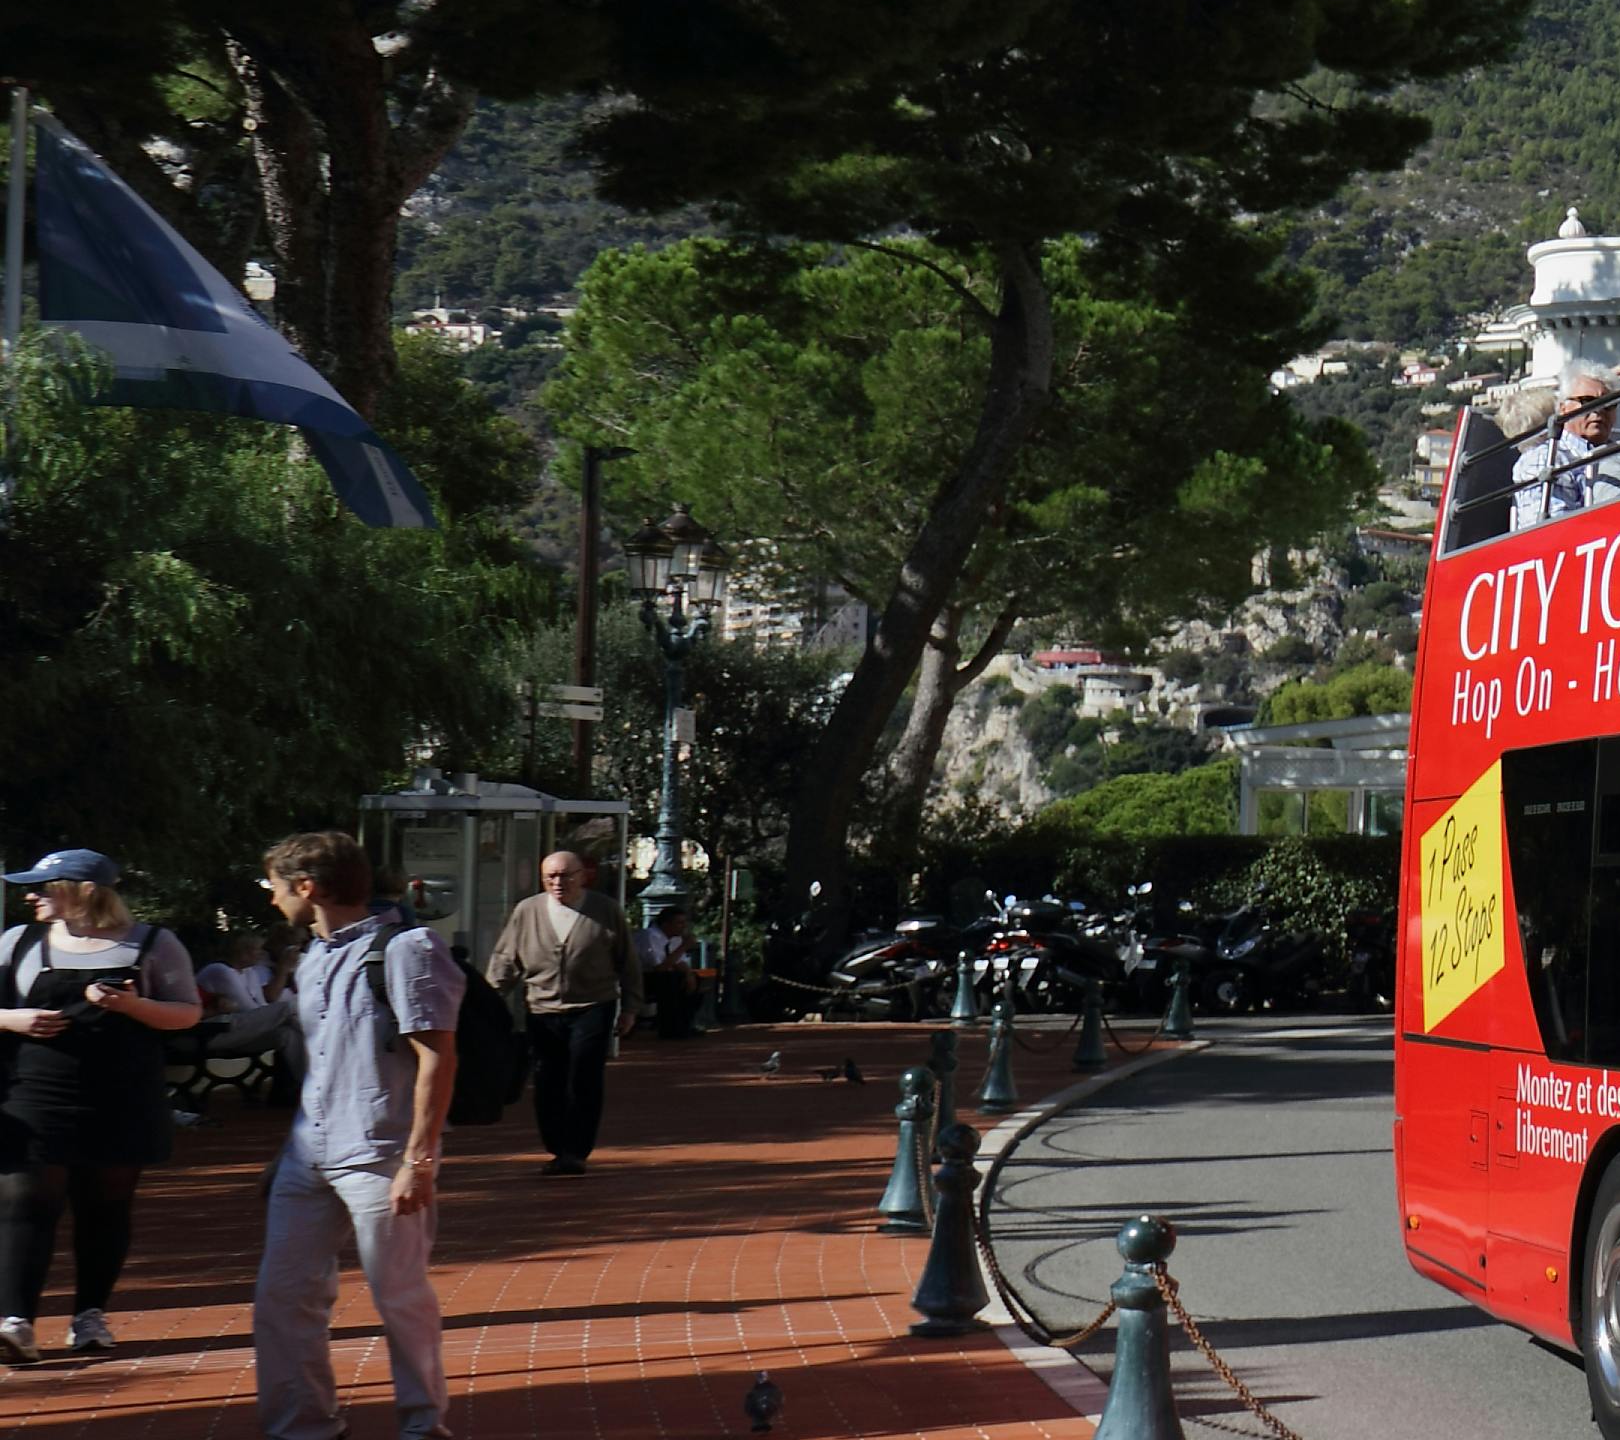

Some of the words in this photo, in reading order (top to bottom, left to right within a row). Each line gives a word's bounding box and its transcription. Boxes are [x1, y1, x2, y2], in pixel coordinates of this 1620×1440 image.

[1460, 551, 1566, 661] CITY
[1452, 669, 1502, 739] Hop
[1515, 656, 1552, 716] On
[1428, 849, 1436, 908] 1
[1440, 814, 1478, 901] Pass
[1430, 923, 1448, 989] 12
[1451, 884, 1496, 984] Stops
[1516, 1064, 1572, 1111] Montez
[1576, 1077, 1592, 1114] et
[1516, 1108, 1588, 1164] librement
